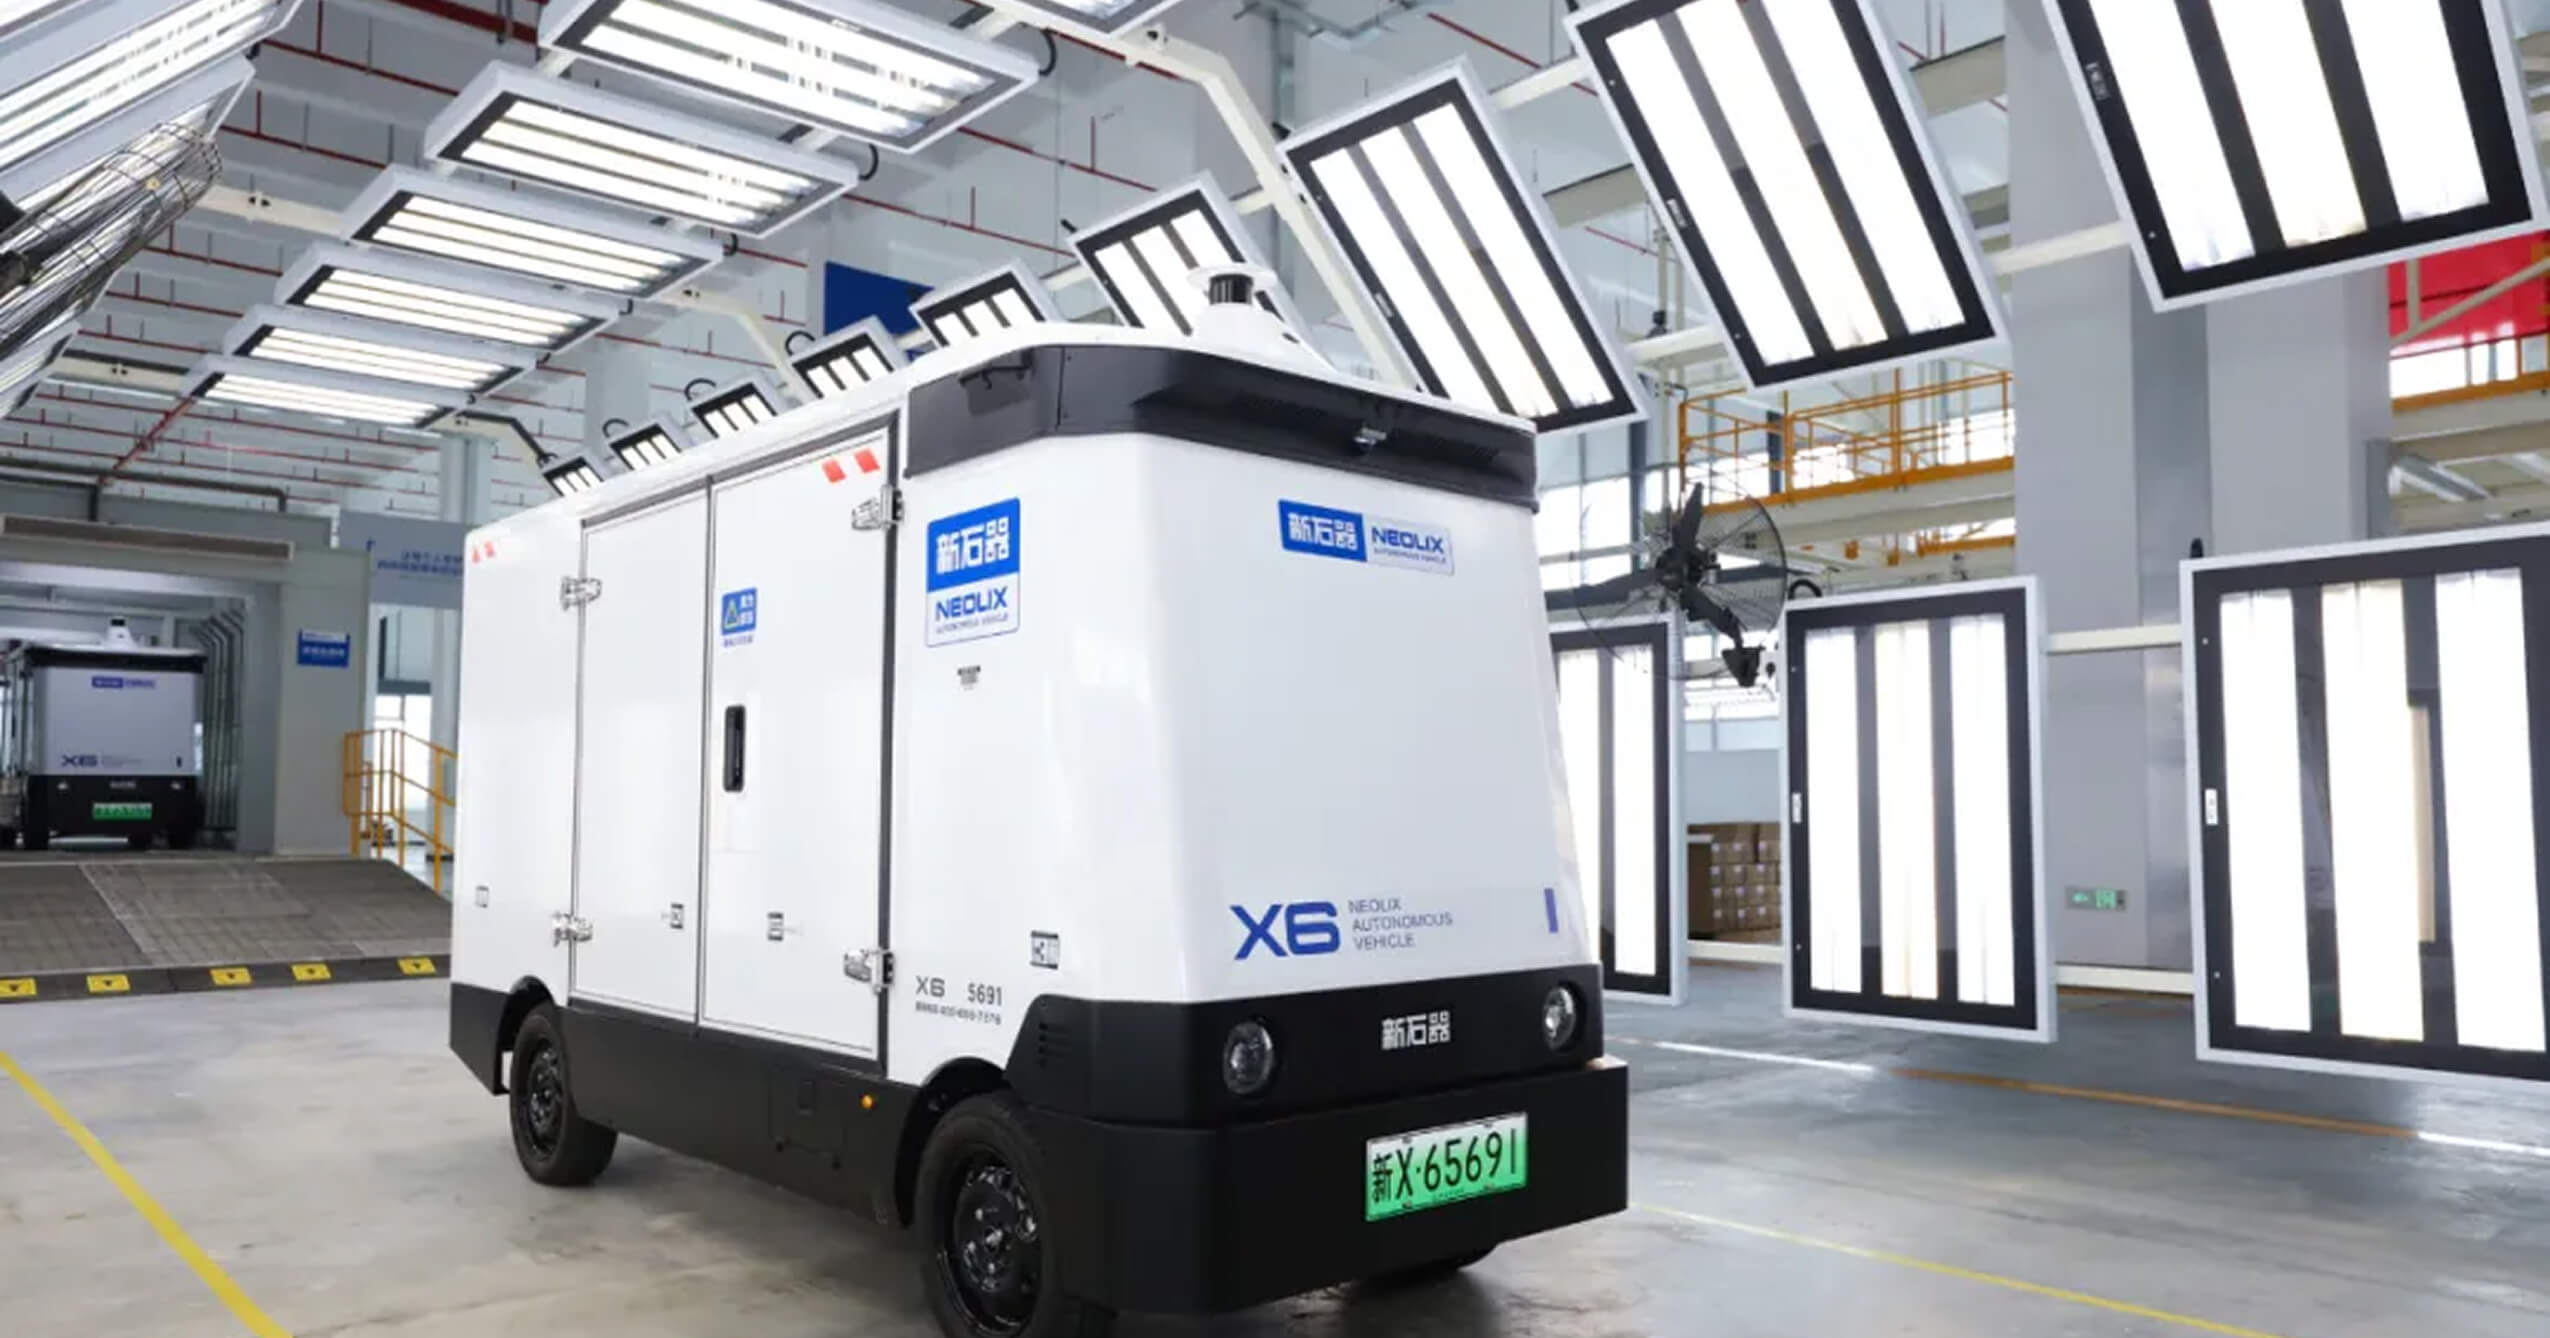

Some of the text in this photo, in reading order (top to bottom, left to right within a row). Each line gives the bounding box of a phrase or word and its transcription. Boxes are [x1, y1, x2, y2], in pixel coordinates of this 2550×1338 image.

[936, 516, 1010, 575] 新石器
[1288, 512, 1359, 551] 新石器
[1371, 526, 1444, 554] NEOLIX
[935, 586, 1008, 621] NEOLIX
[1348, 898, 1402, 913] NEOLIX
[1352, 912, 1453, 932] AUTONOMOUS
[1230, 901, 1341, 960] X6
[1354, 933, 1416, 950] VEHICLE
[915, 975, 1002, 1006] X6 5691
[1381, 1010, 1451, 1050] 新石器
